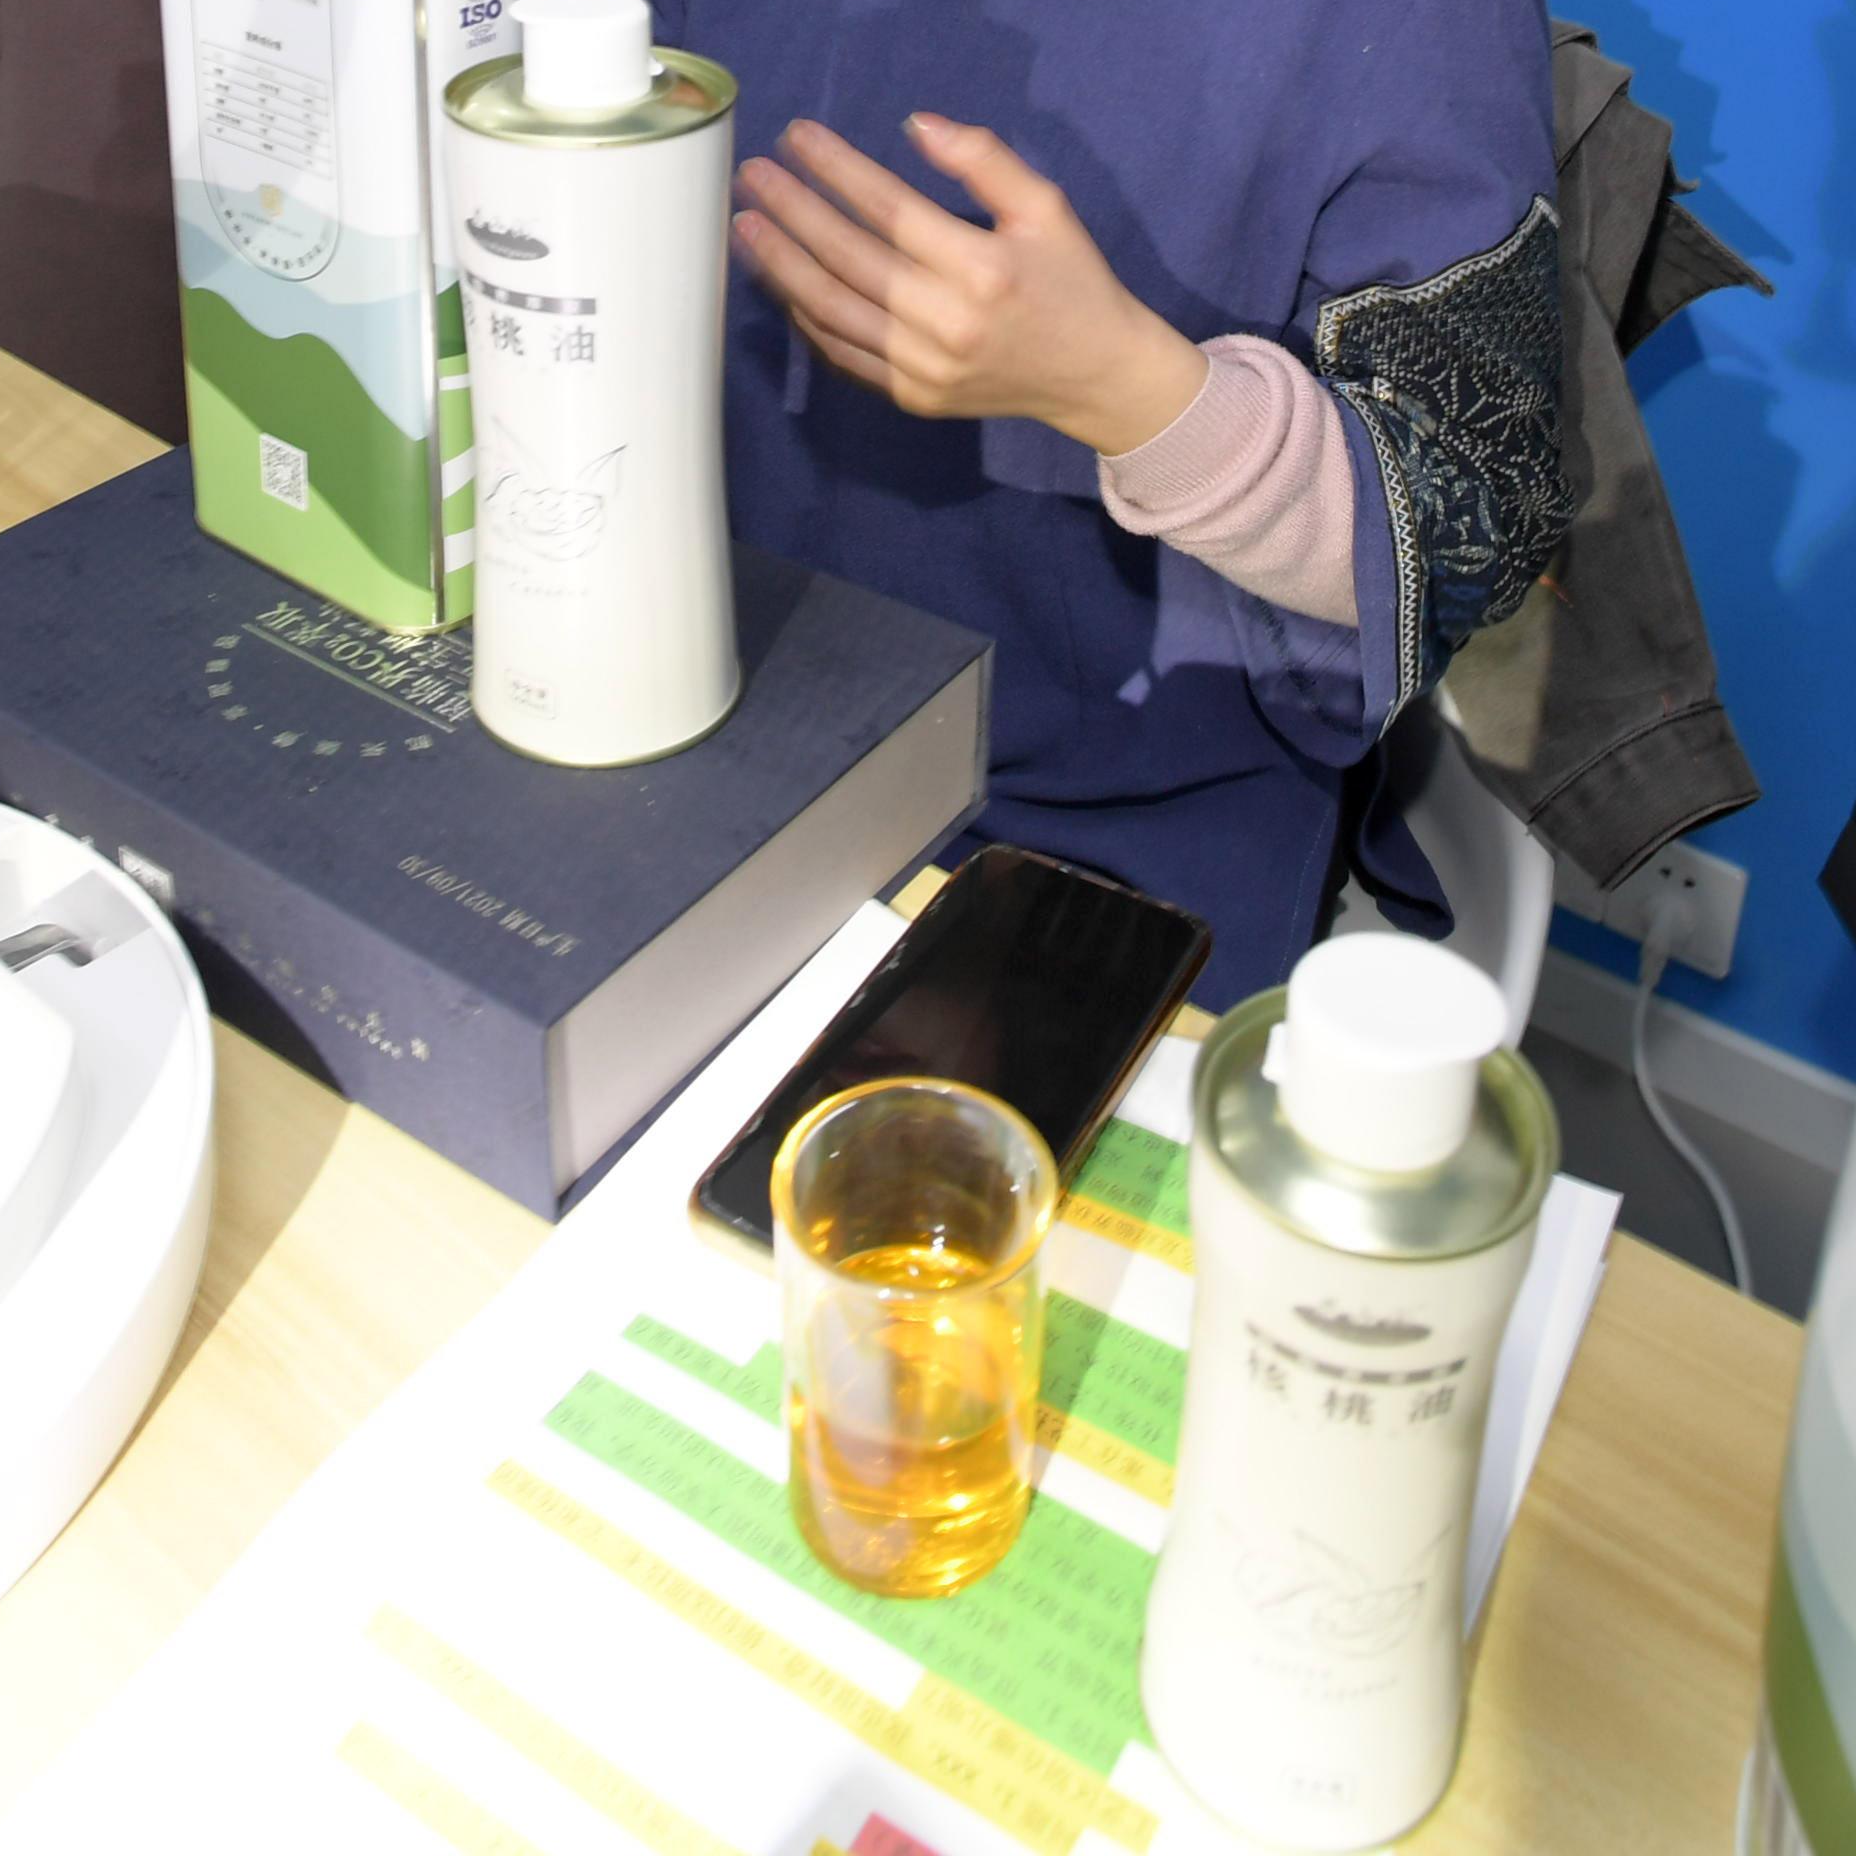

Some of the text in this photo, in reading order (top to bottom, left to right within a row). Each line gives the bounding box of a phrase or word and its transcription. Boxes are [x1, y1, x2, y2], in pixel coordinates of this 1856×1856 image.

[397, 854, 507, 918] 2021/09/30
[1247, 1347, 1457, 1425] 核桃油
